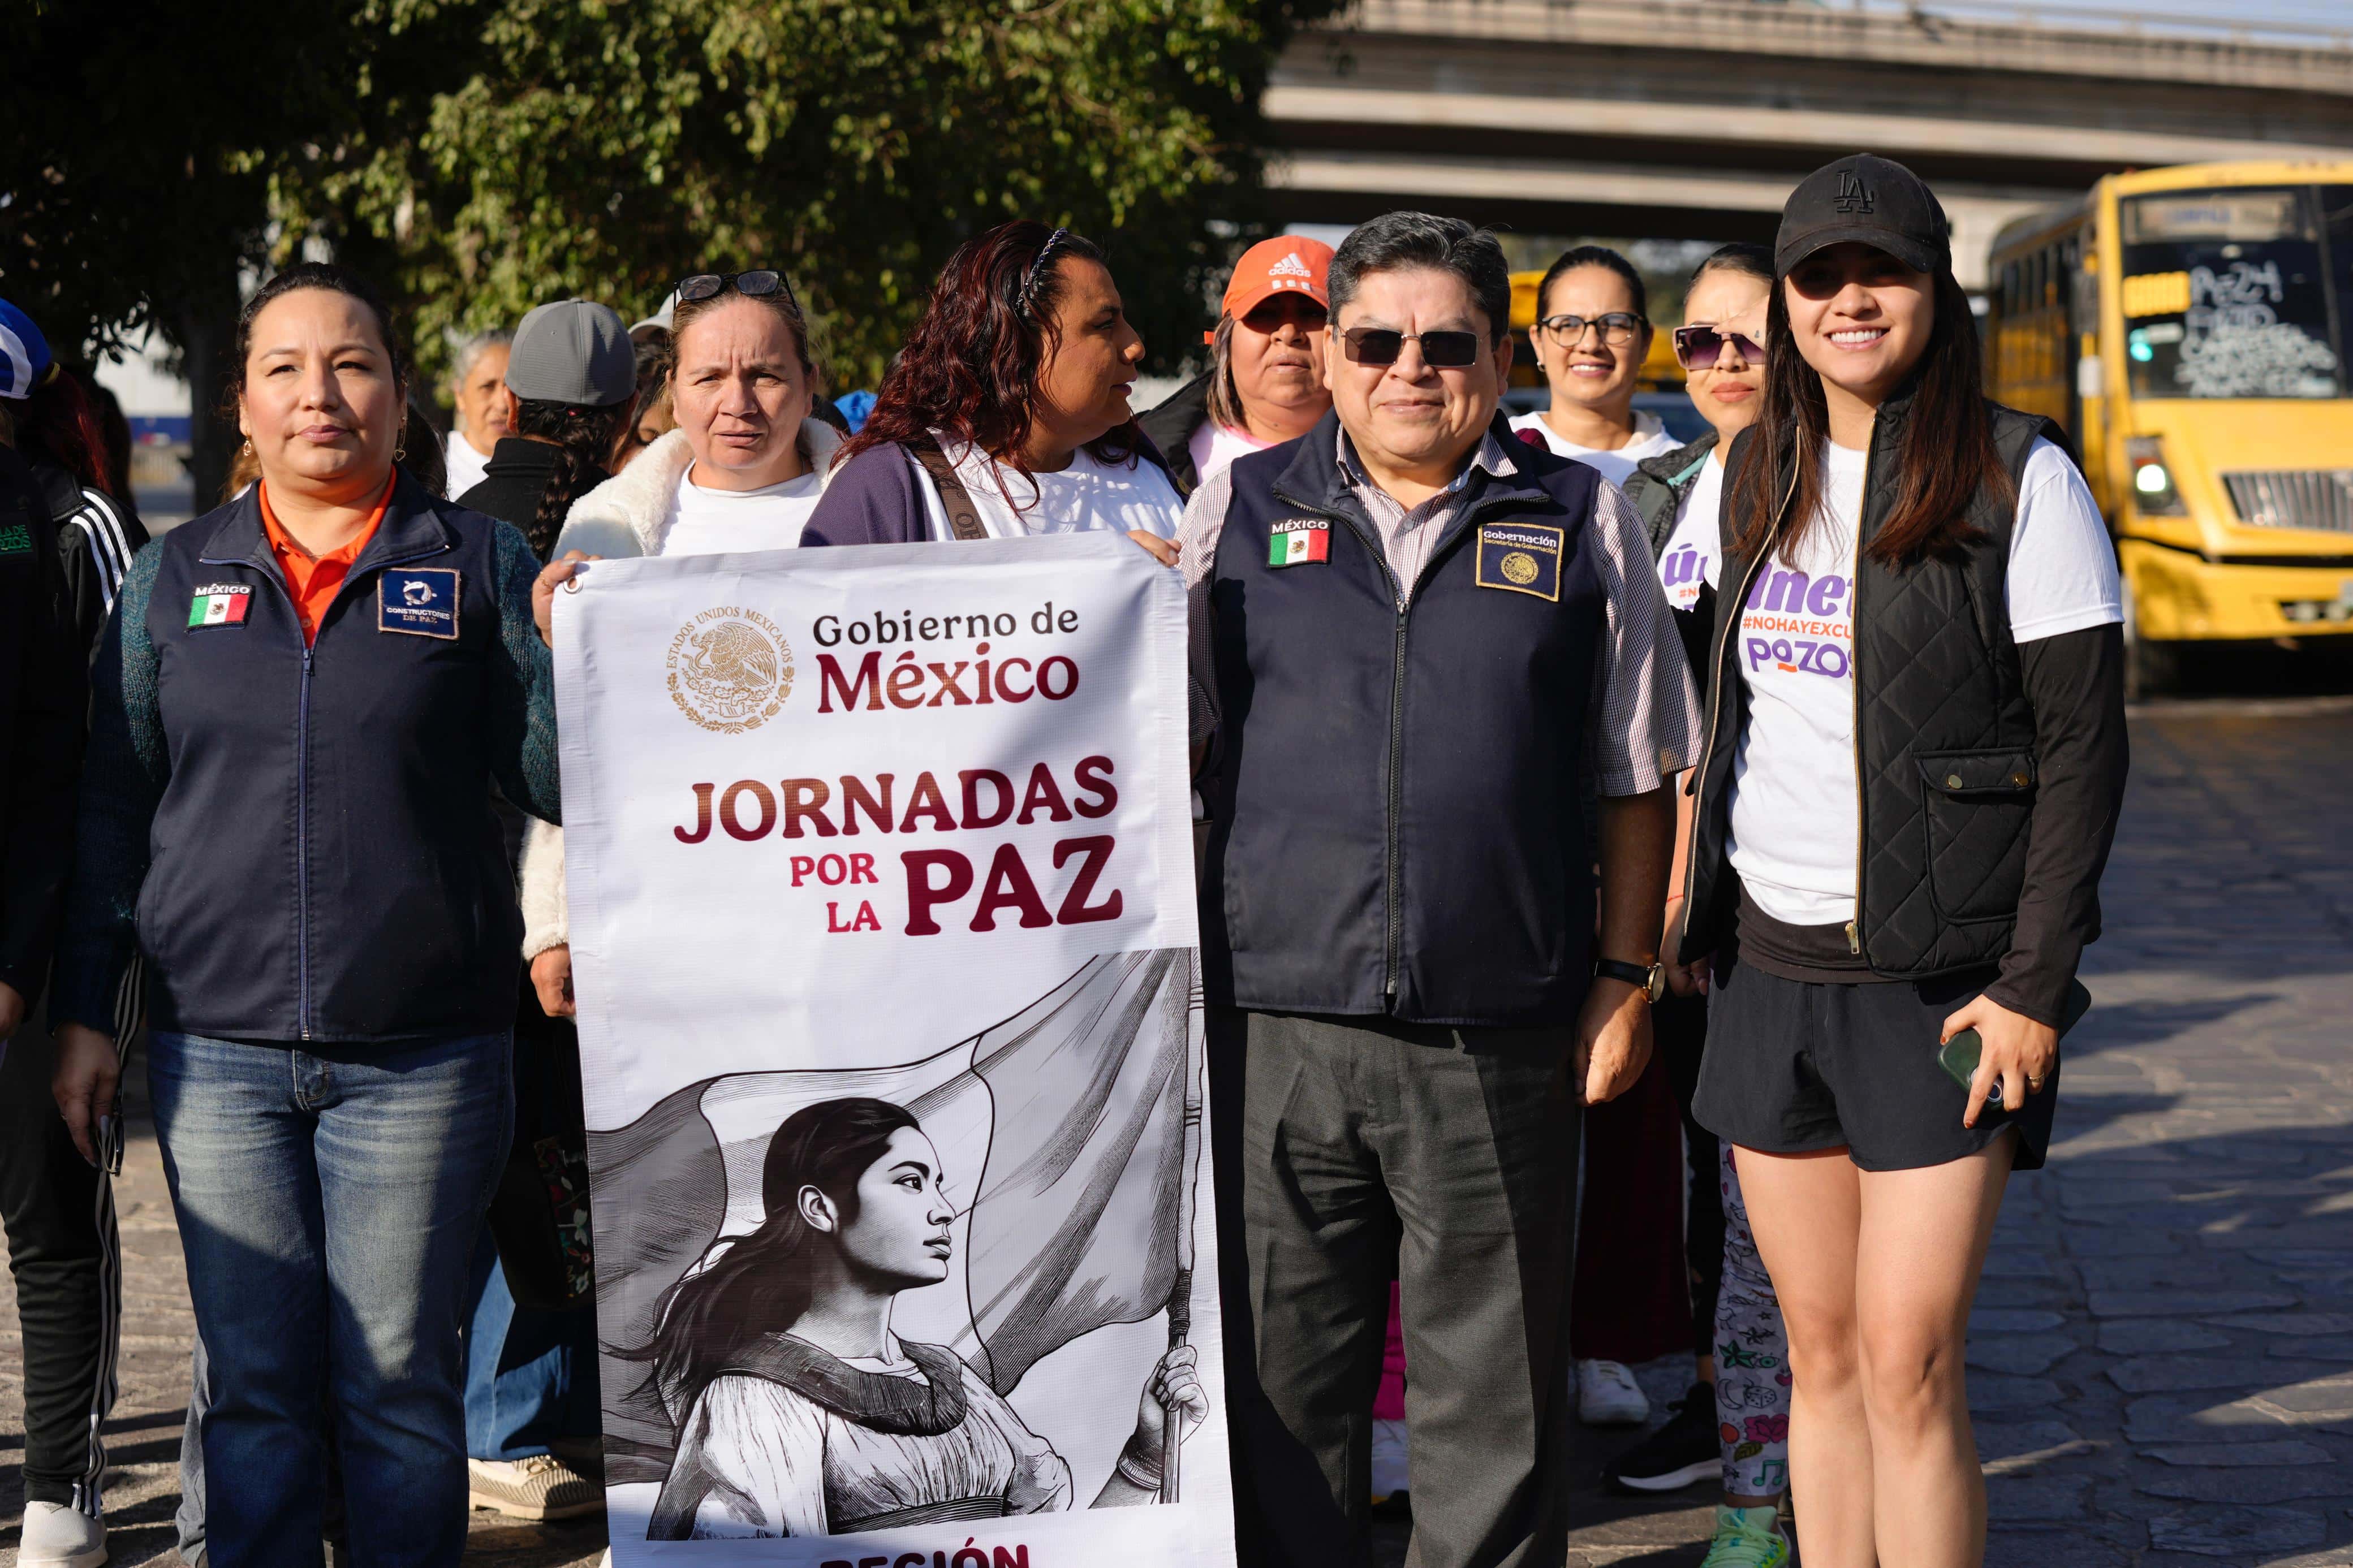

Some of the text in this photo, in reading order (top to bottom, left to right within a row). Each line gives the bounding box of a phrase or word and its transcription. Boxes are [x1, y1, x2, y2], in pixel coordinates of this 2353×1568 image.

[1833, 170, 1874, 213] LA
[1269, 267, 1311, 278] adidas
[1272, 519, 1329, 534] MÉXICO
[1484, 530, 1557, 547] Gobernación
[1484, 538, 1513, 547] Secretaría
[1521, 543, 1557, 555] Gobernación
[195, 584, 250, 596] MÉXICO
[386, 607, 450, 620] CONSTRUCTORES
[813, 601, 1079, 647] Gobierno de
[667, 606, 793, 669] ESTADOS UNIDOS MEXICANOS
[816, 642, 1079, 713] México
[674, 755, 1118, 844] JORNADAS
[790, 853, 878, 887] POR
[826, 835, 1123, 936] LA PAZ
